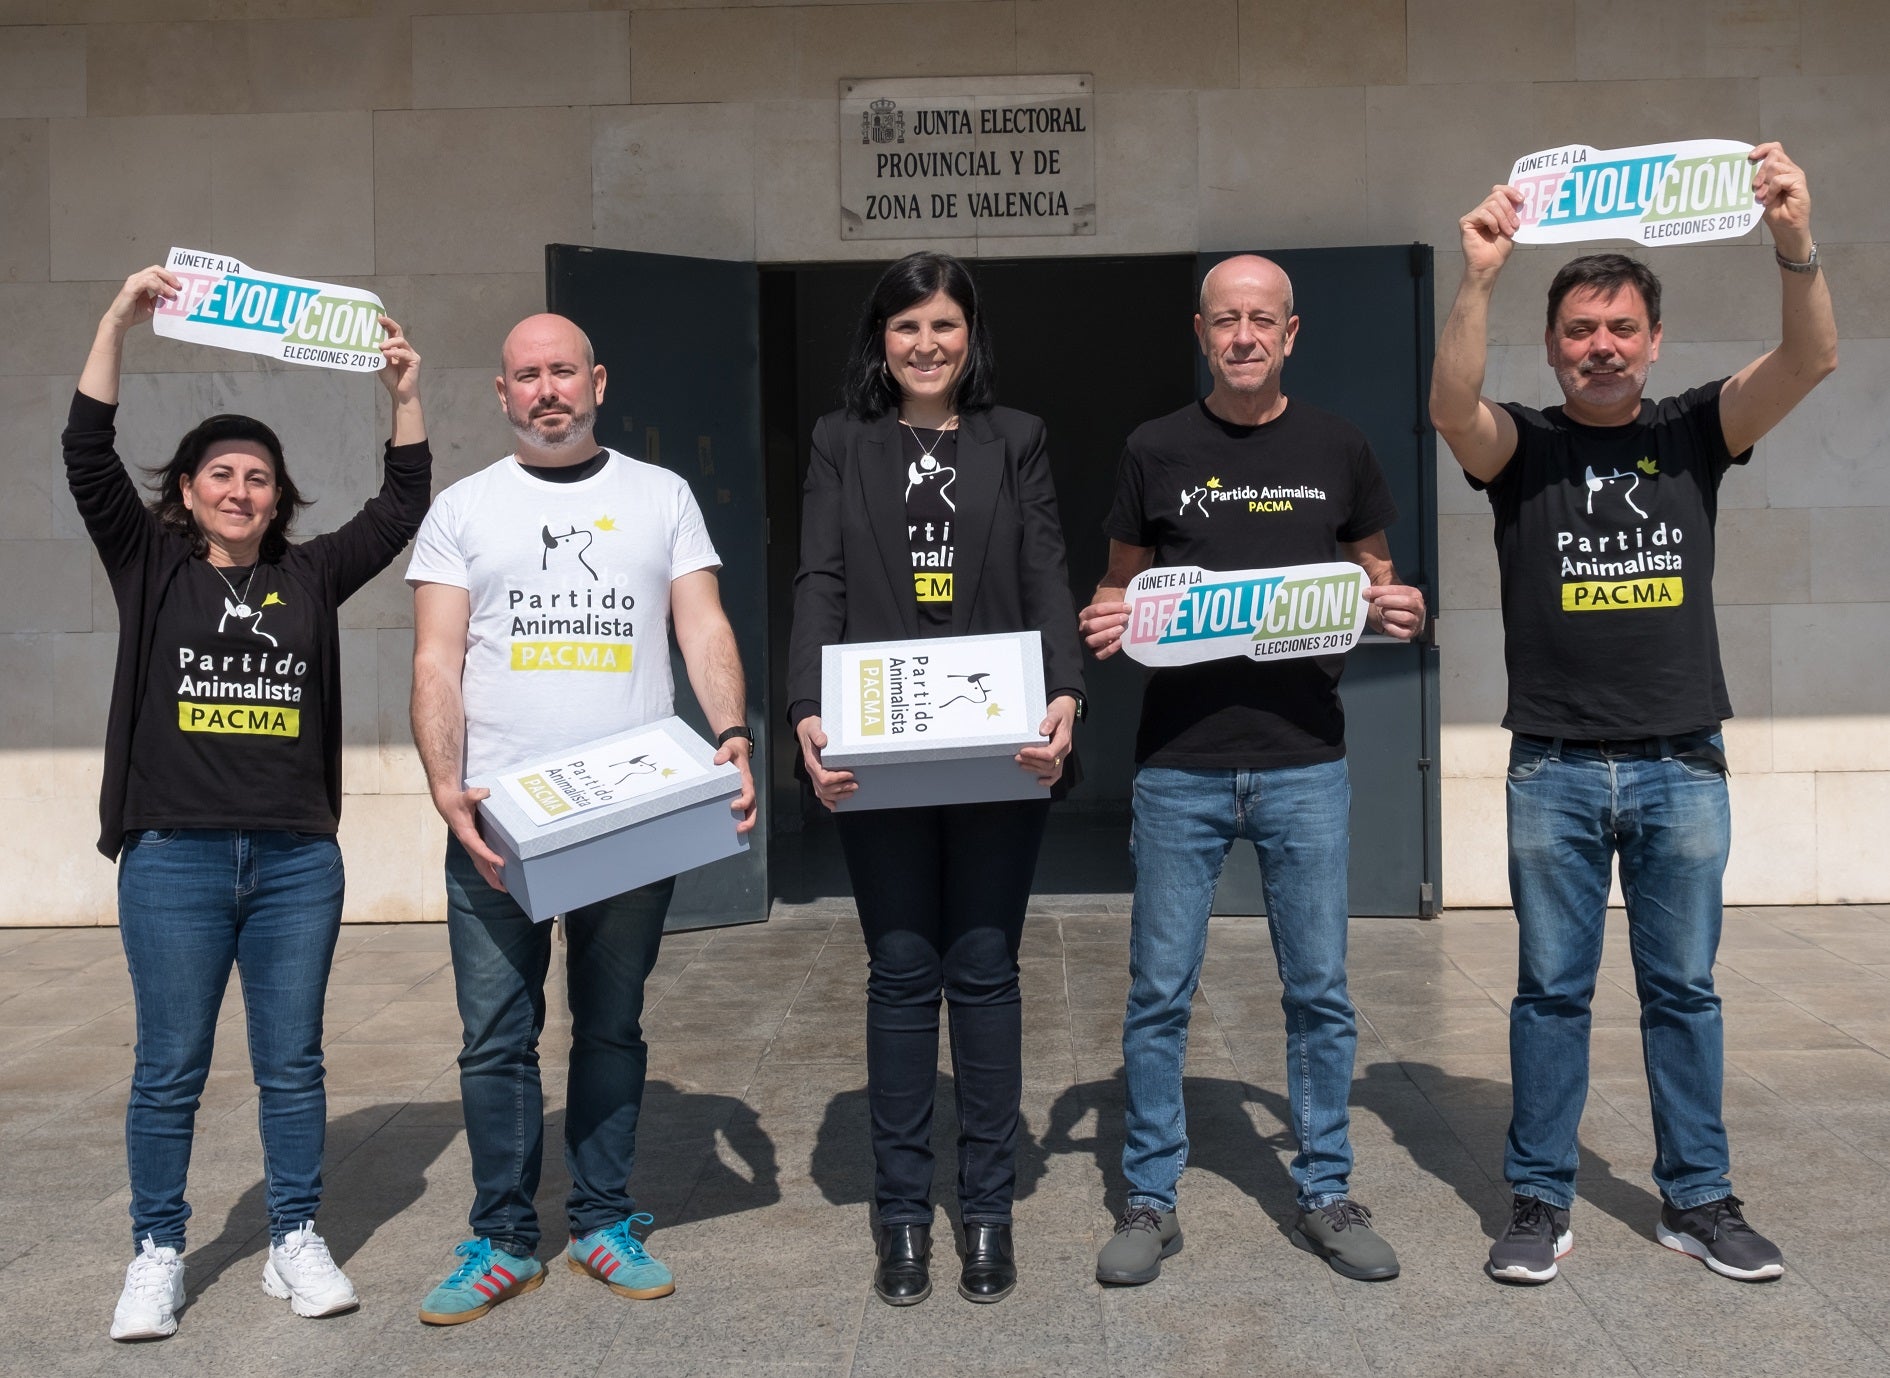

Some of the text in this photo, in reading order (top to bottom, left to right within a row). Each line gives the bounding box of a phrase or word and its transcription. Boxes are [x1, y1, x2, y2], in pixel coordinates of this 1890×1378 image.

[914, 107, 1086, 135] JUNTA ELECTORAL
[877, 150, 1061, 177] PROVINCIAL Y DE
[1517, 149, 1587, 174] ¡ÚNETE A LA
[866, 191, 1069, 219] ZONA DE VALENCIA
[1643, 213, 1751, 240] ELECCIONES 2019
[173, 251, 241, 274] ¡ÚNETE A LA
[283, 346, 380, 368] ELECCIONES 2019
[1211, 485, 1326, 502] Partido Animalista
[1249, 500, 1293, 512] PACMA
[1558, 522, 1683, 552] Partido
[1561, 551, 1682, 577] Animalista
[1137, 570, 1202, 591] ¡ÚNETE A LA
[1574, 582, 1672, 605] PACMA
[509, 587, 635, 610] Partido
[511, 613, 634, 637] Animalista
[522, 645, 617, 667] PACMA
[1254, 632, 1352, 656] ELECCIONES 2019
[179, 647, 307, 676] Partido
[177, 675, 302, 702] Animalista
[863, 666, 881, 727] PACMA
[889, 657, 910, 735] Animalista
[912, 656, 934, 732] Partido
[191, 707, 287, 731] PACMA
[545, 767, 592, 808] Animalista
[568, 760, 614, 802] Partido
[525, 779, 564, 812] PACMA
